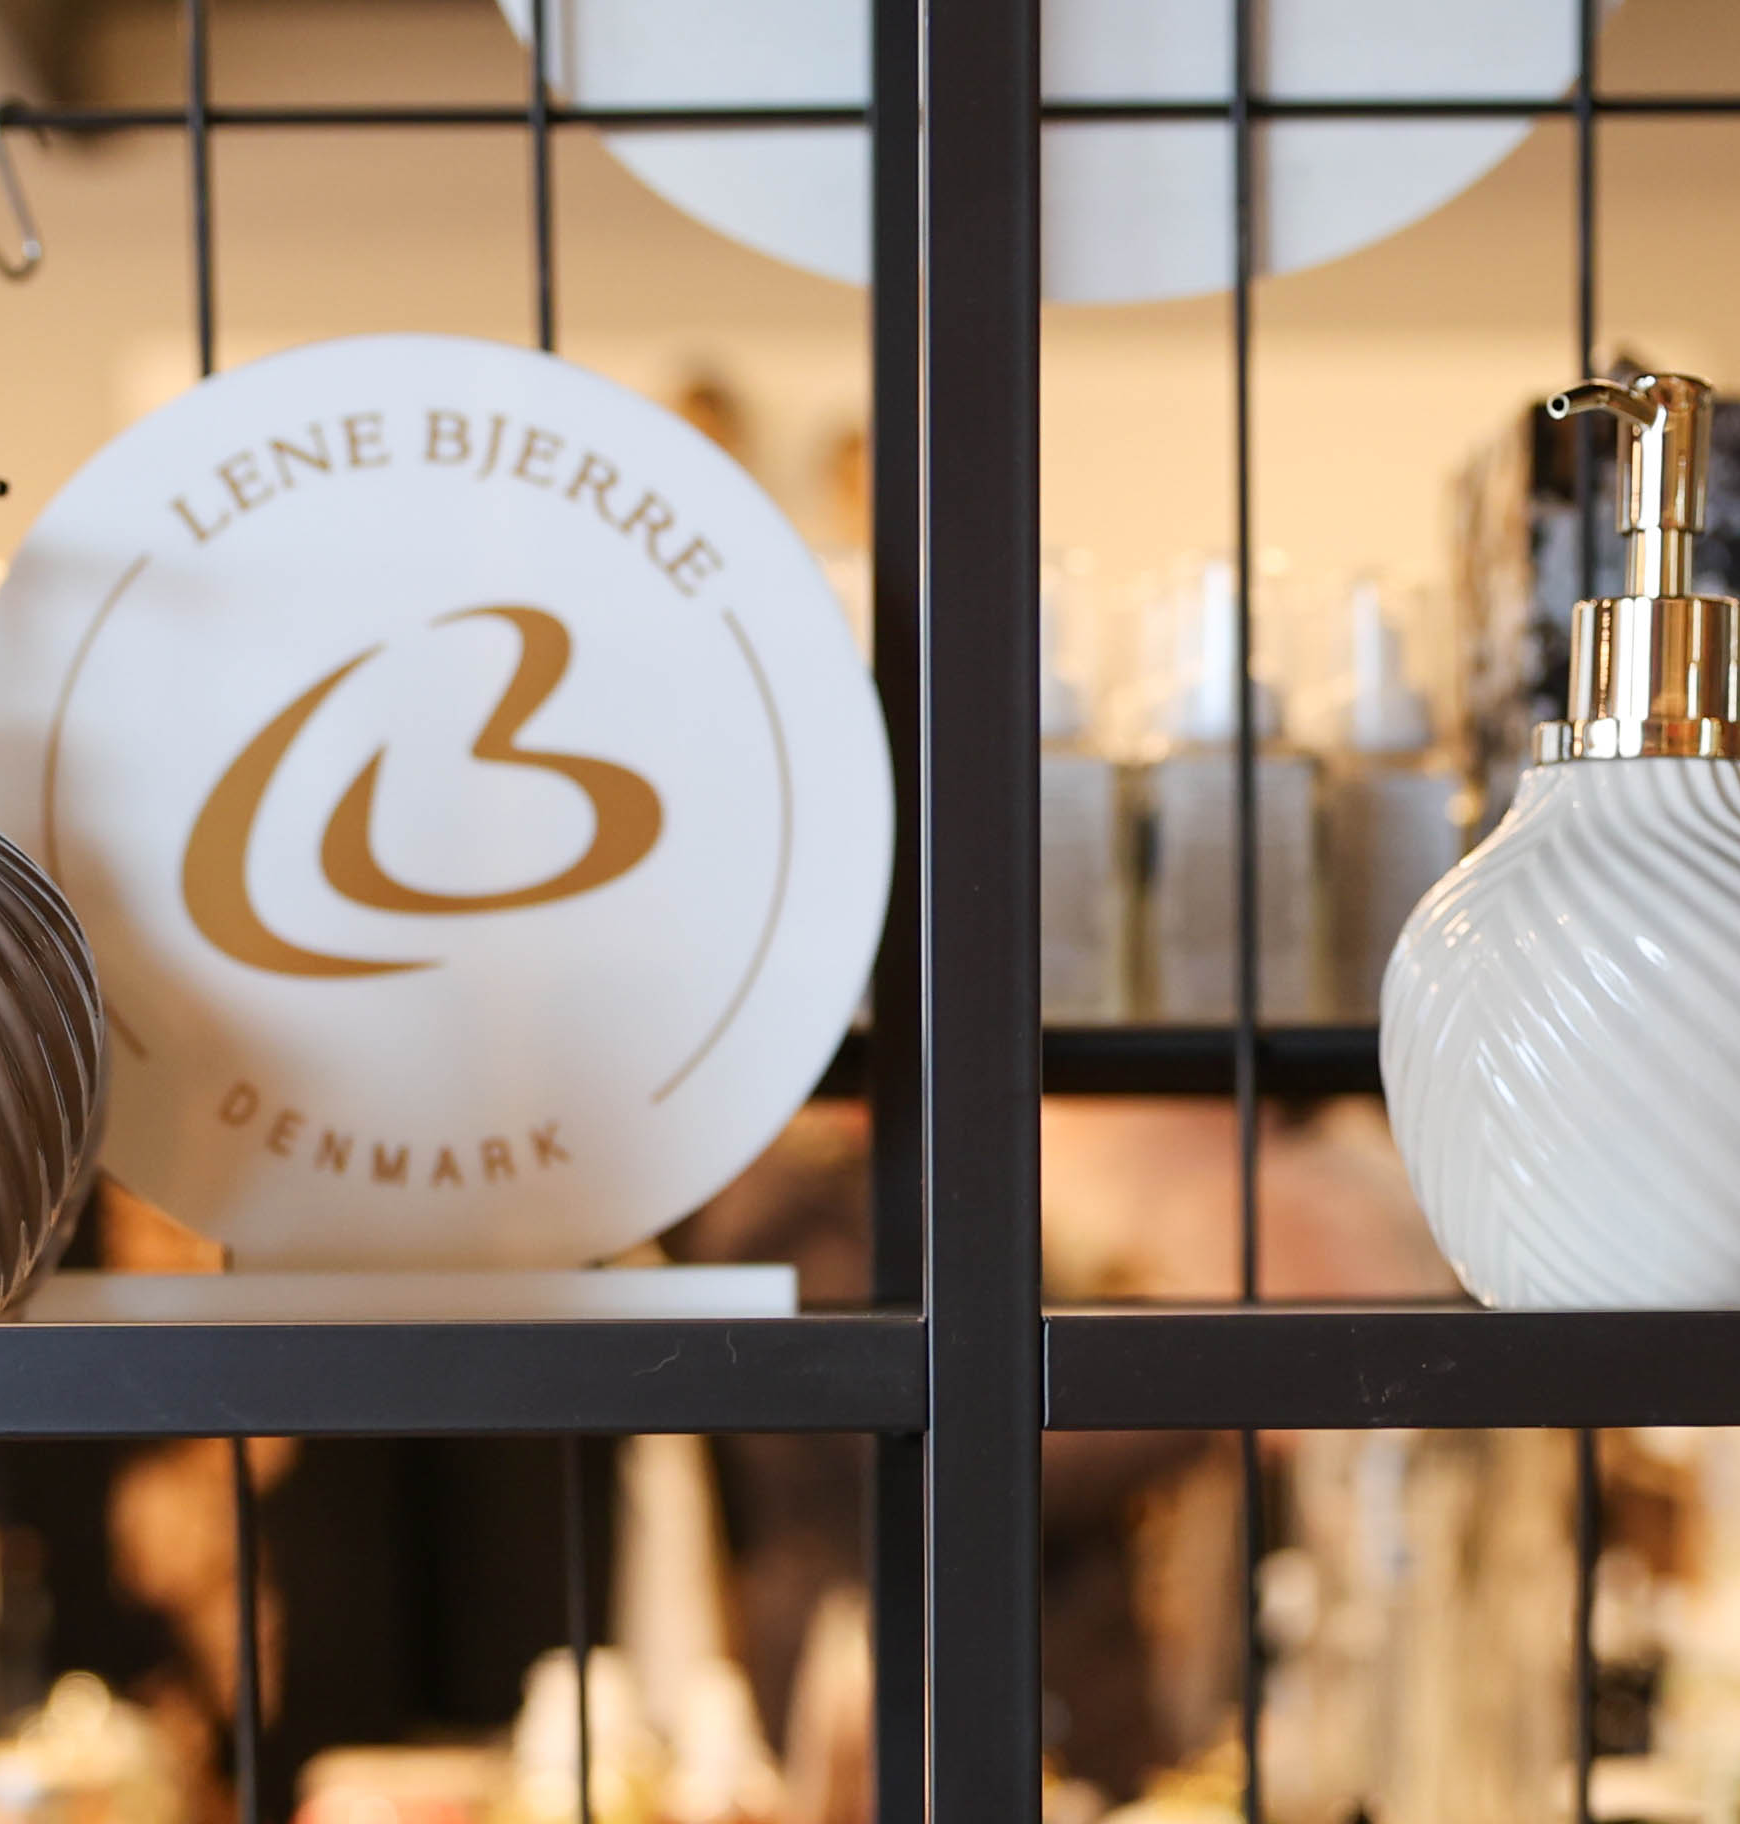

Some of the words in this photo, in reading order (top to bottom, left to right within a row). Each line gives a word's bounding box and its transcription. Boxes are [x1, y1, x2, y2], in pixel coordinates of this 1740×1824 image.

[168, 411, 392, 545] LENE
[421, 409, 726, 597] BJERRE
[218, 1081, 574, 1188] DENMARK
